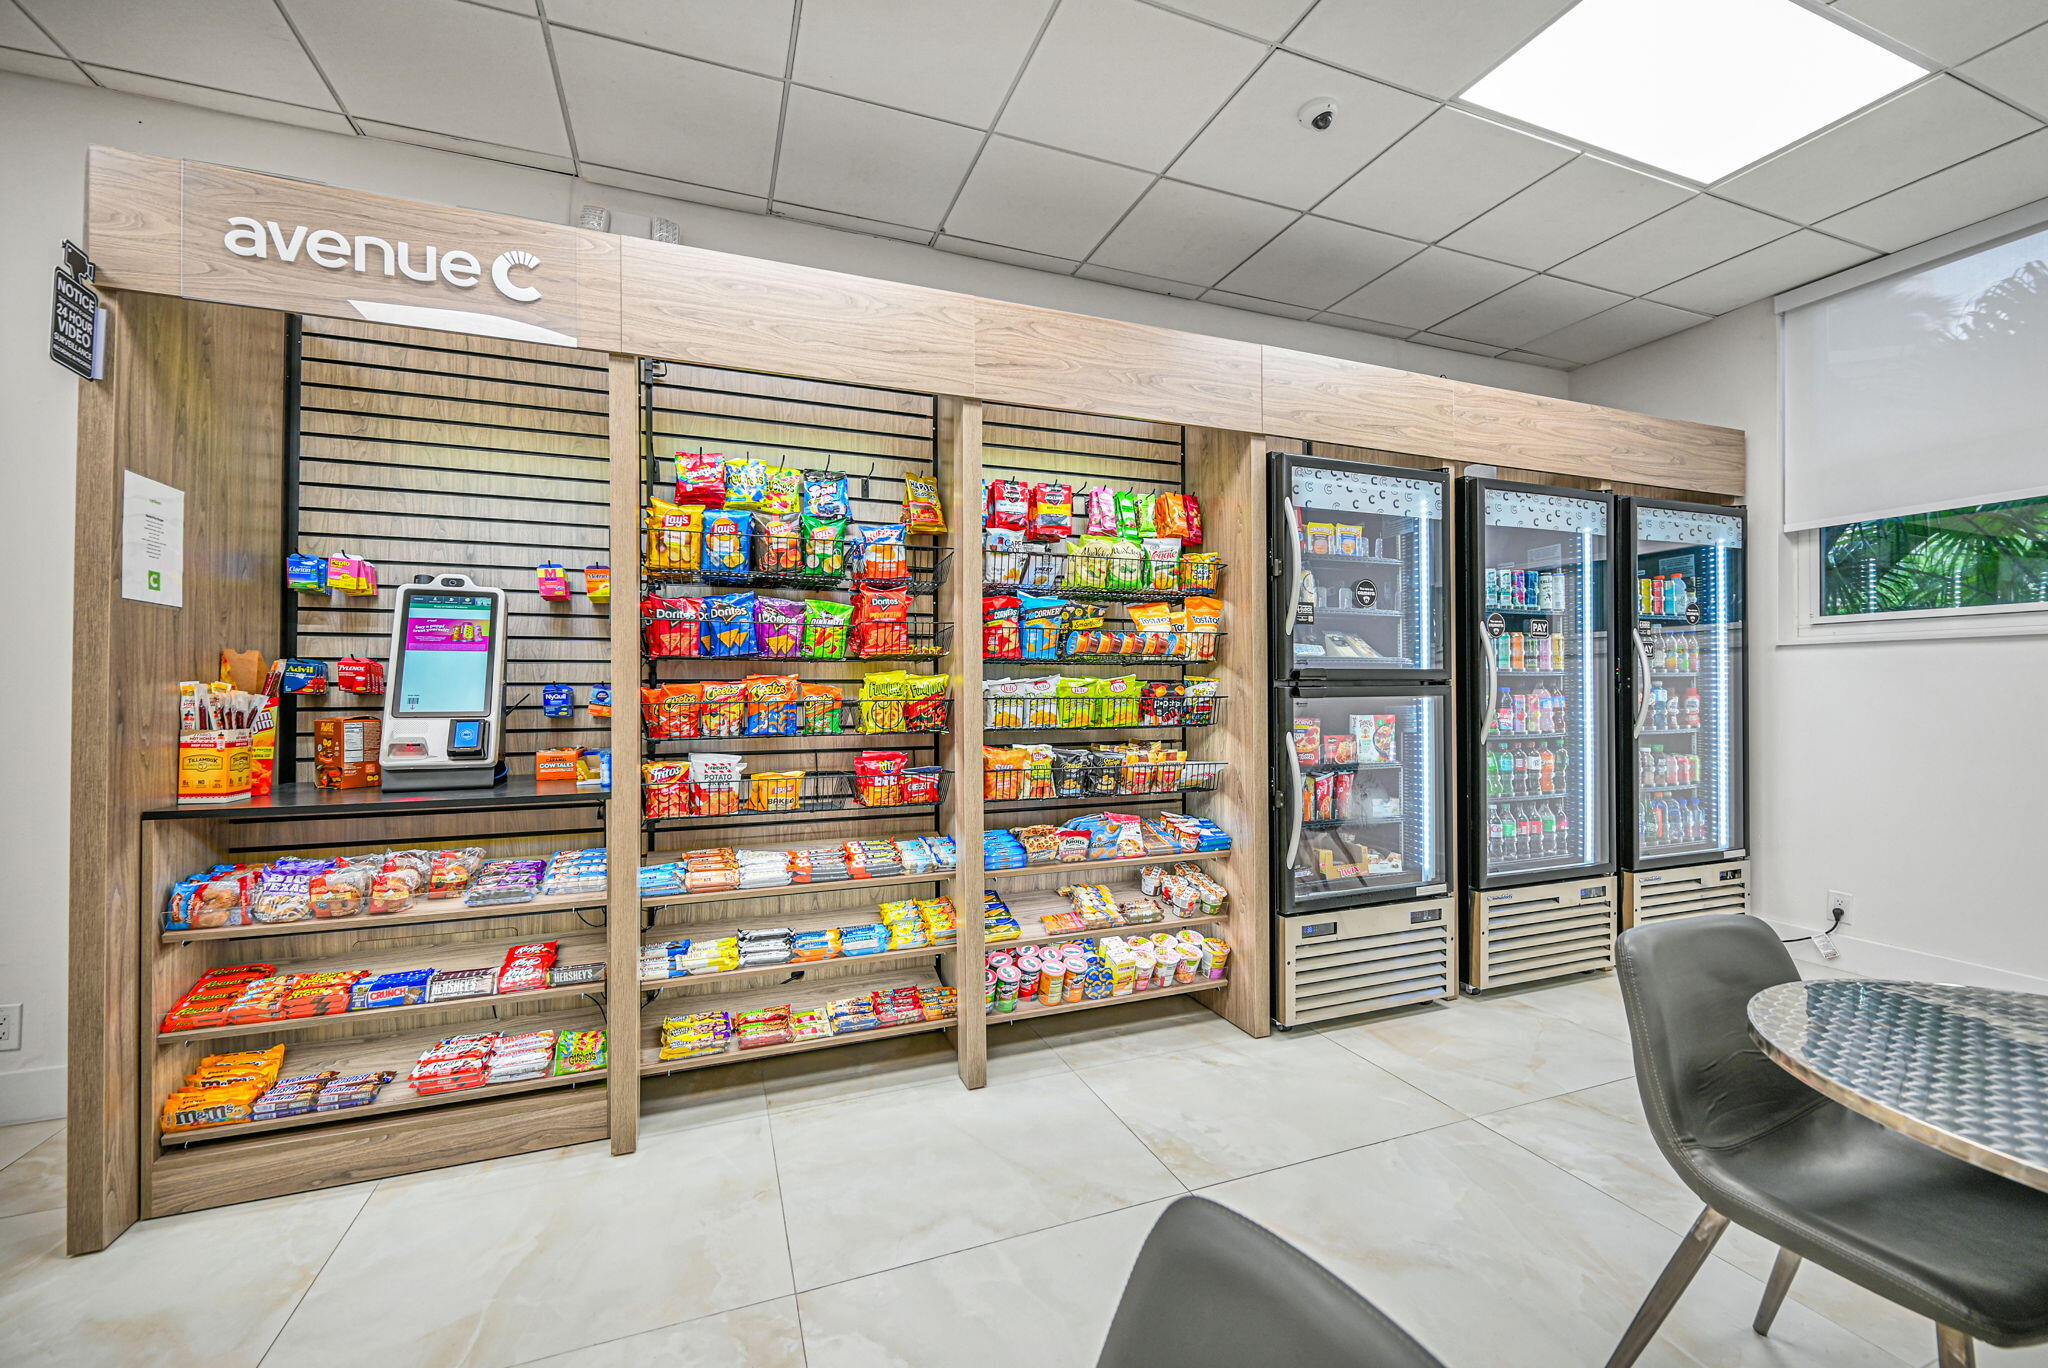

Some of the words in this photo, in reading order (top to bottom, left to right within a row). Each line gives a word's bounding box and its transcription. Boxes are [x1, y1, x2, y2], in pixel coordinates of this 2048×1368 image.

[224, 216, 481, 287] avenue
[57, 277, 95, 314] NOTICE
[56, 302, 68, 318] 24
[69, 310, 93, 336] HOUR
[58, 316, 91, 348] VIDEO
[53, 332, 93, 361] SURVEILLANCE
[687, 467, 723, 479] Skittles
[909, 480, 936, 492] HARIBO
[664, 515, 689, 527] Lay's
[713, 523, 736, 534] Lay's
[768, 524, 789, 535] Lay's
[813, 528, 833, 539] Lay's
[330, 559, 350, 567] Pepto
[872, 598, 898, 606] Doritos
[656, 609, 696, 619] Doritos
[710, 607, 747, 618] Doritos
[762, 613, 797, 624] Doritos
[1532, 623, 1547, 632] PAY
[706, 685, 739, 701] Cheetos
[750, 682, 786, 700] Cheetos
[664, 694, 697, 712] Cheetos
[880, 761, 896, 771] RITZ
[650, 767, 681, 783] Fritos
[1338, 866, 1360, 877] TWIX
[262, 882, 308, 892] TEXAS
[553, 969, 593, 983] HERSHEY'S
[369, 985, 407, 1001] CRUNCH
[432, 979, 477, 996] HERSHEY'S
[176, 1104, 234, 1125] m&m's
